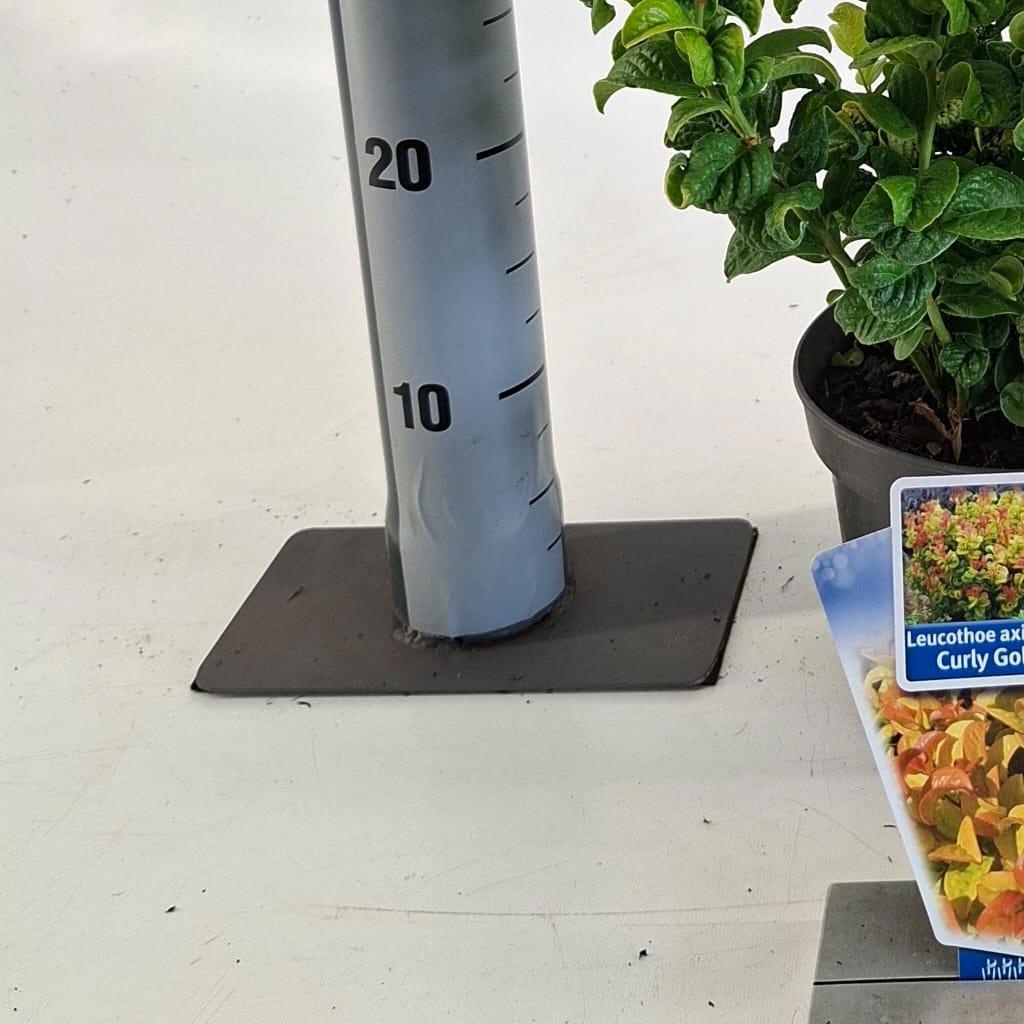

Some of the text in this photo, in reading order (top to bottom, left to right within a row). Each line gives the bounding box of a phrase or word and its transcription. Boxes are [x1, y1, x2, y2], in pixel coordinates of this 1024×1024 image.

[365, 138, 432, 192] 20
[394, 383, 452, 432] 10
[907, 627, 995, 647] Leucothoe
[936, 648, 989, 672] Curly
